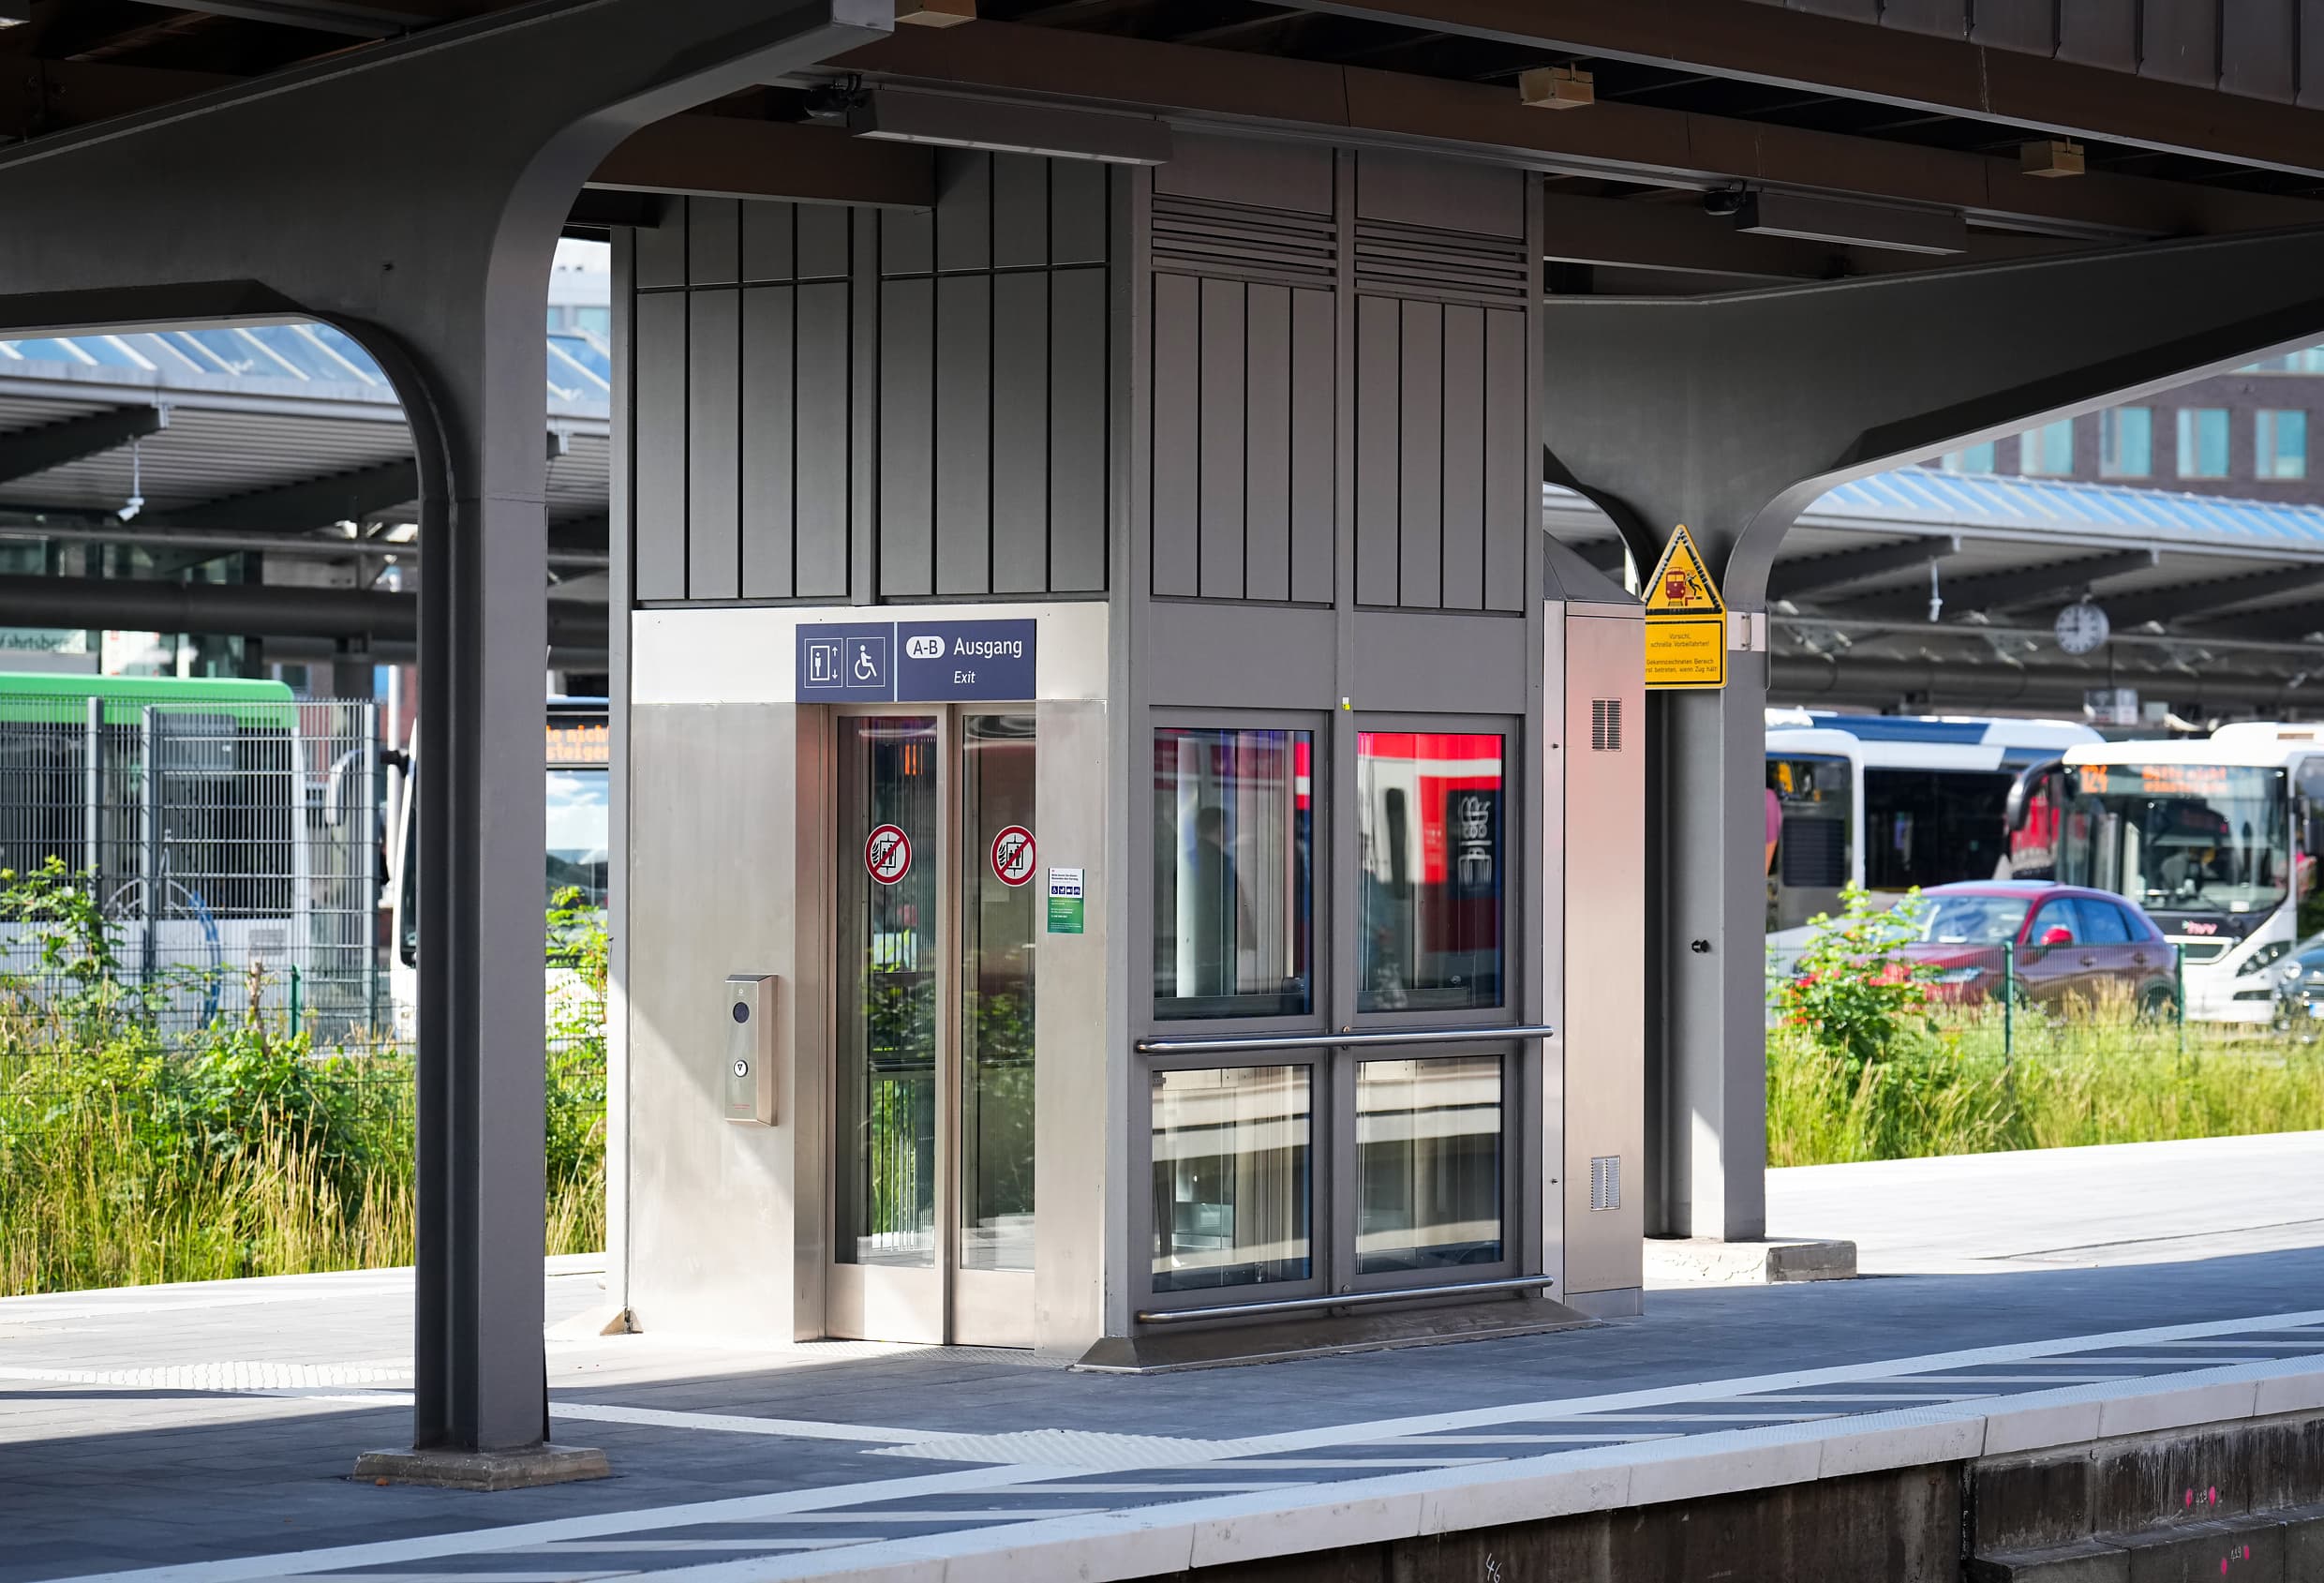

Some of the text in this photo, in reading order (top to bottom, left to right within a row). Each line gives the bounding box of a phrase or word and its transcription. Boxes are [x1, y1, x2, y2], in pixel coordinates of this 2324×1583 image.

[913, 637, 1022, 659] A-B Ausgang
[954, 670, 976, 684] Exit
[566, 724, 609, 743] nich
